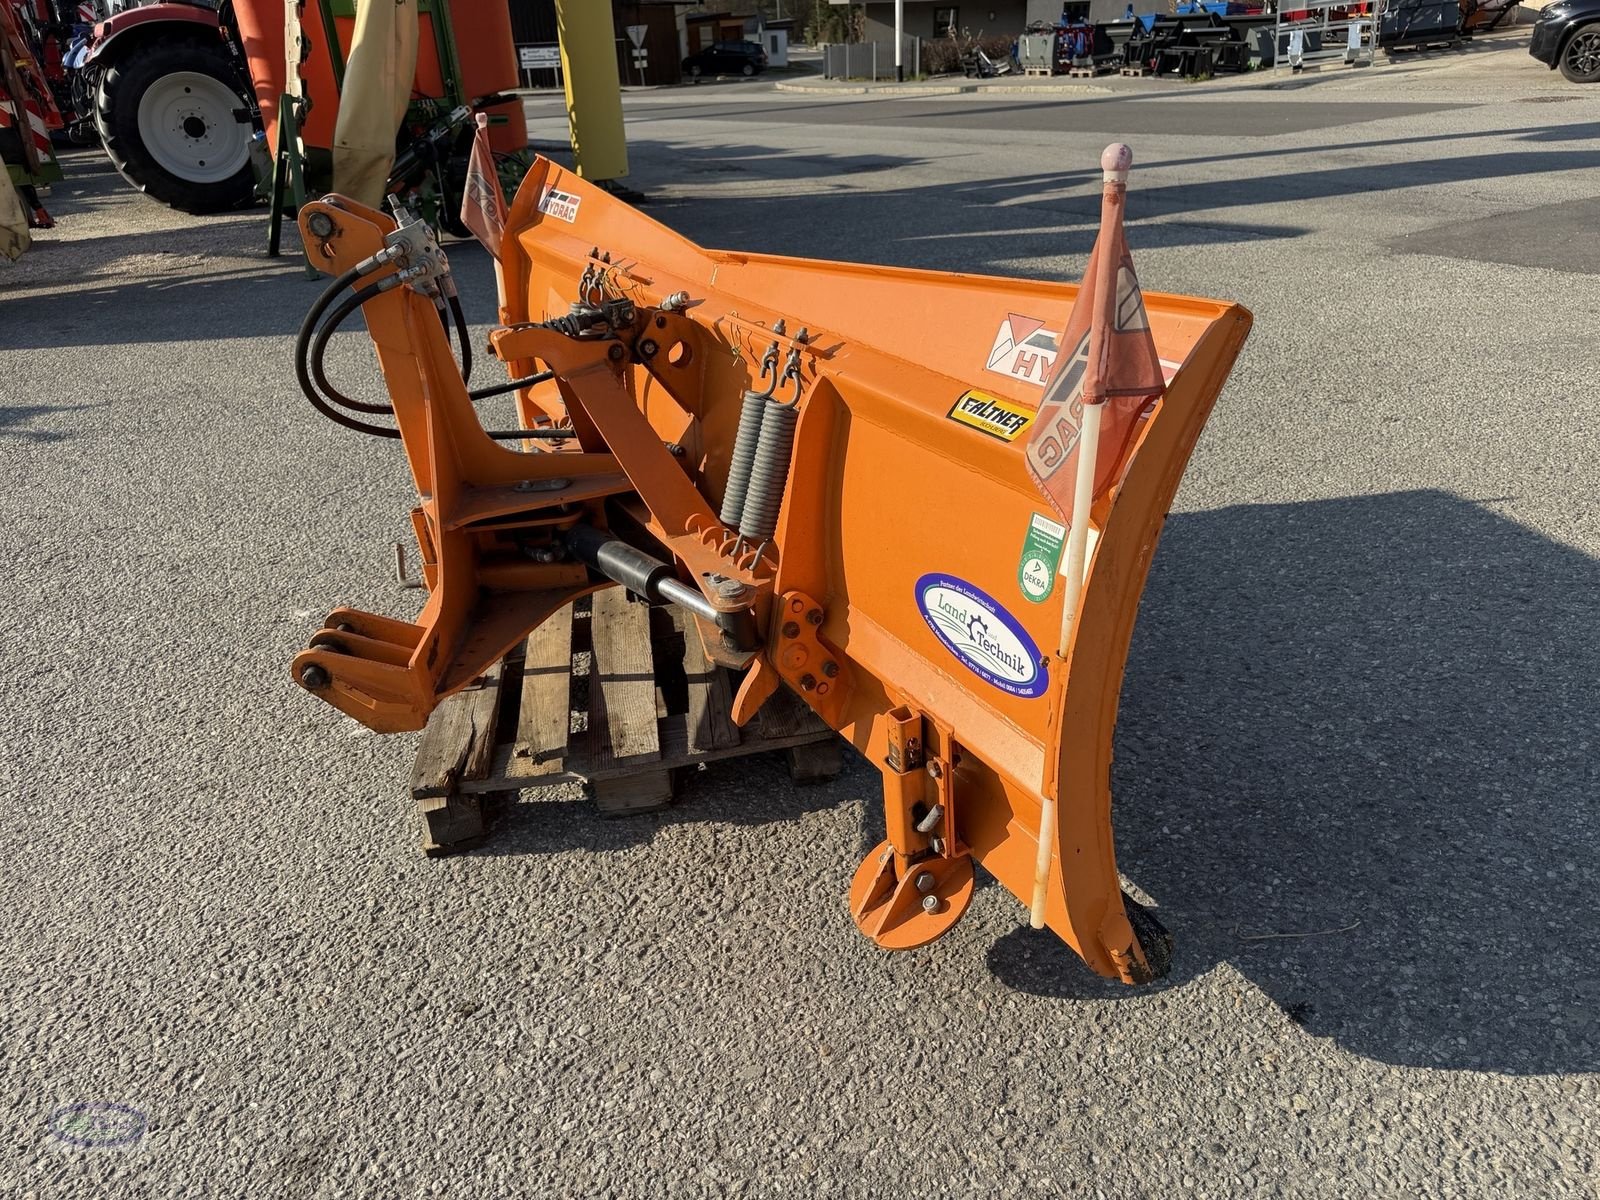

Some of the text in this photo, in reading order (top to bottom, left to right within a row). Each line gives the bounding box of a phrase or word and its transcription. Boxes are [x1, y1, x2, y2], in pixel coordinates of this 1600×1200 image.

[543, 199, 575, 221] HYDRAC
[960, 396, 1029, 435] FALTNER
[1023, 572, 1046, 589] DEKRA
[938, 593, 967, 625] Land
[976, 631, 1024, 676] Technik
